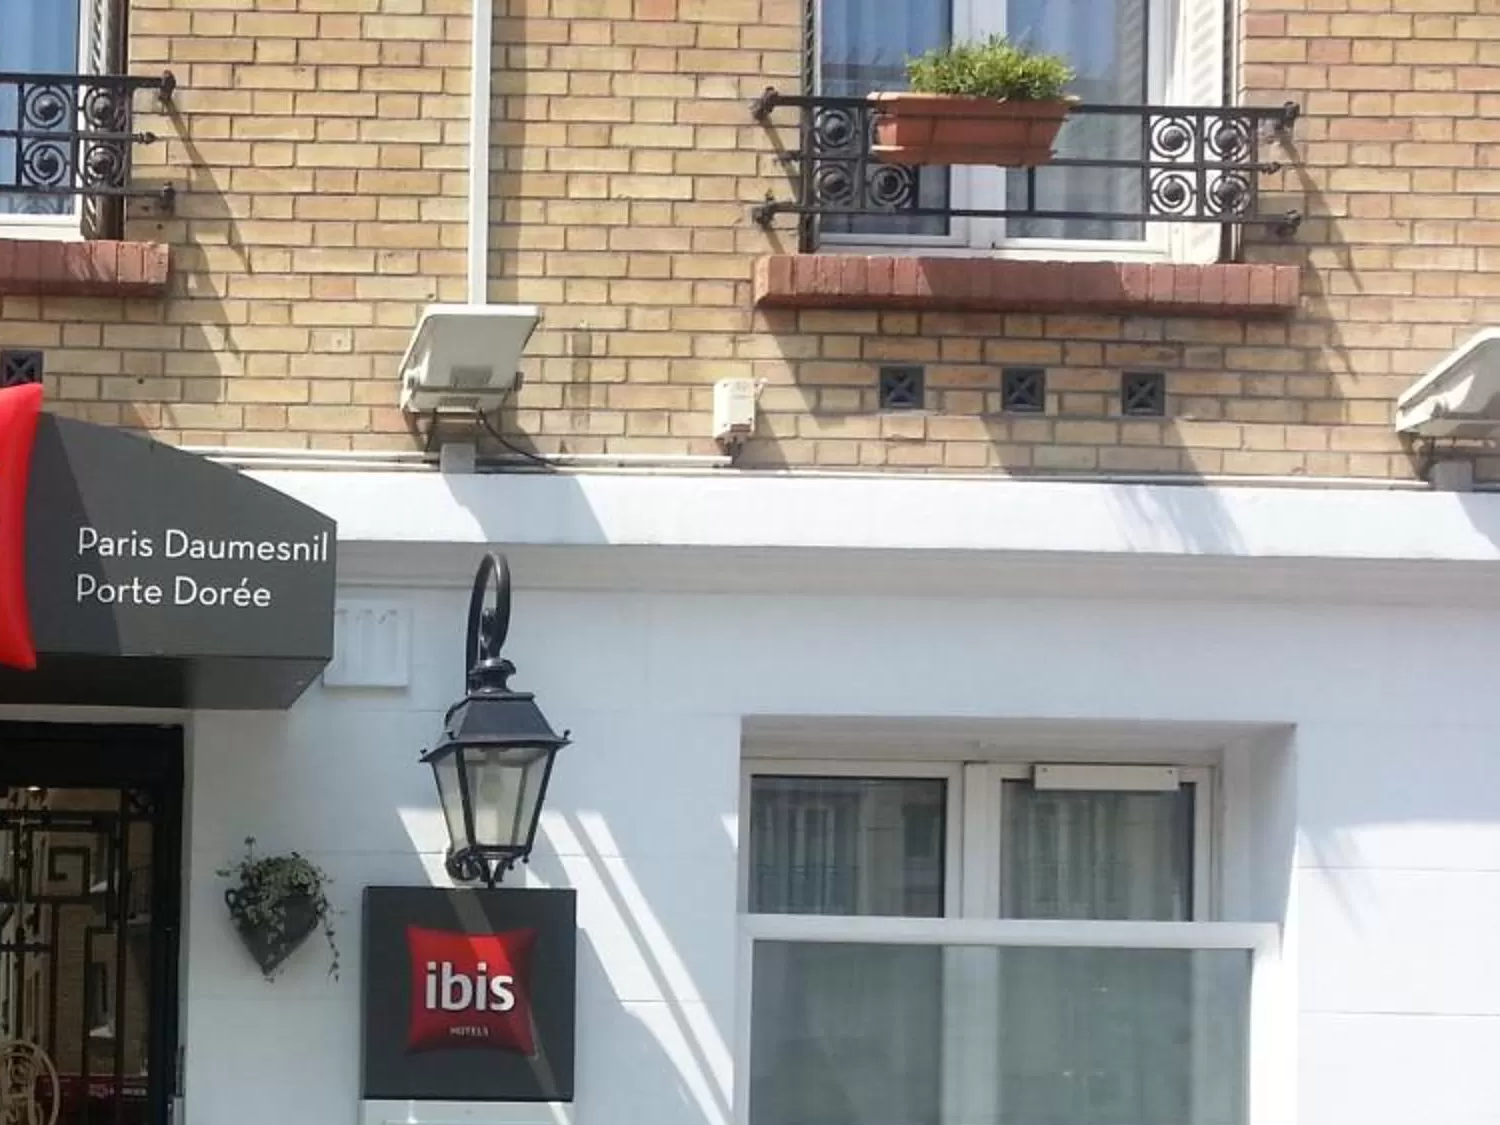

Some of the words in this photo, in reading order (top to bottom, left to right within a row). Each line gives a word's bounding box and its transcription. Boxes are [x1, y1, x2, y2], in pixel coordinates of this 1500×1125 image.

[77, 526, 154, 559] Paris
[165, 530, 329, 563] Daumesnil
[77, 573, 163, 606] Porte
[174, 575, 272, 608] Dorée
[426, 961, 515, 1011] ibis
